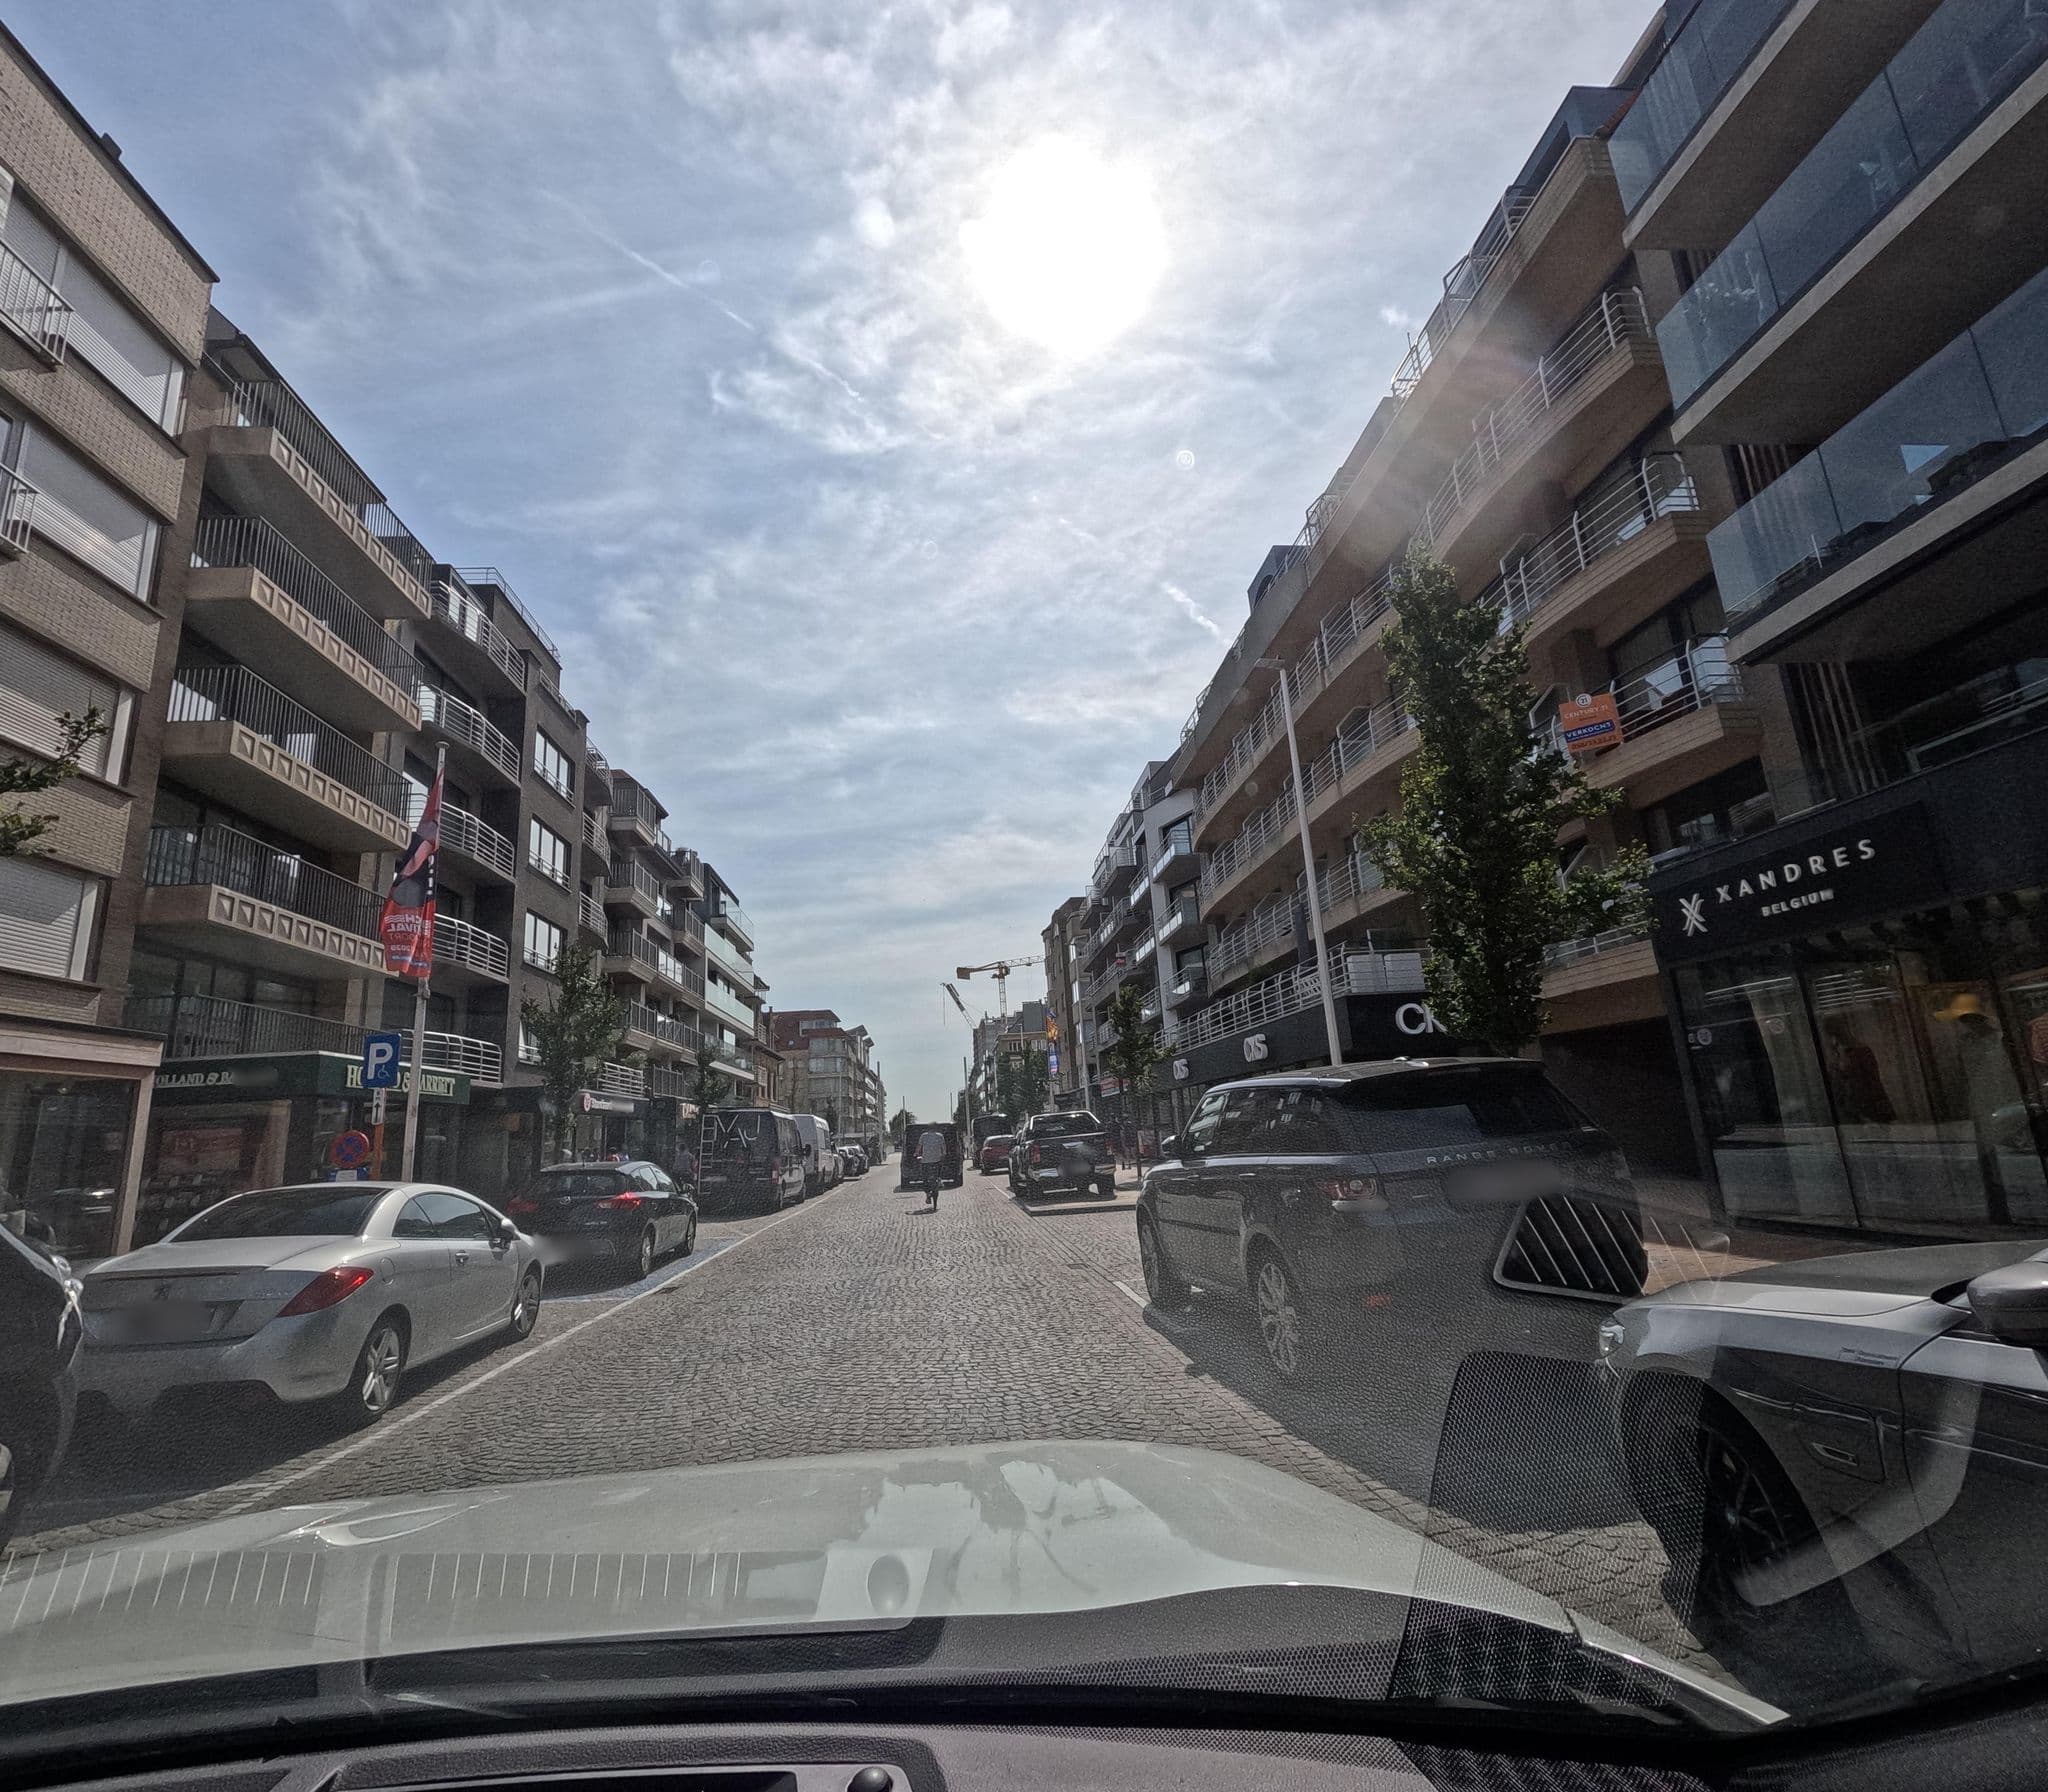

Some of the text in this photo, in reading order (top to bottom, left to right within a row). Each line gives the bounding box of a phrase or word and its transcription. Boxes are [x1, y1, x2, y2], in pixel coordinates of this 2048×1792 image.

[1564, 708, 1599, 719] CENTURY
[1566, 721, 1611, 738] VERKOCHT
[1716, 839, 1875, 903] XANDRES
[1761, 888, 1834, 917] BELGIUM
[1395, 1003, 1447, 1034] CK
[367, 1042, 393, 1080] P
[156, 1072, 204, 1087] OLLAND
[420, 1074, 455, 1095] ARRETT
[1427, 1151, 1496, 1164] RANGE
